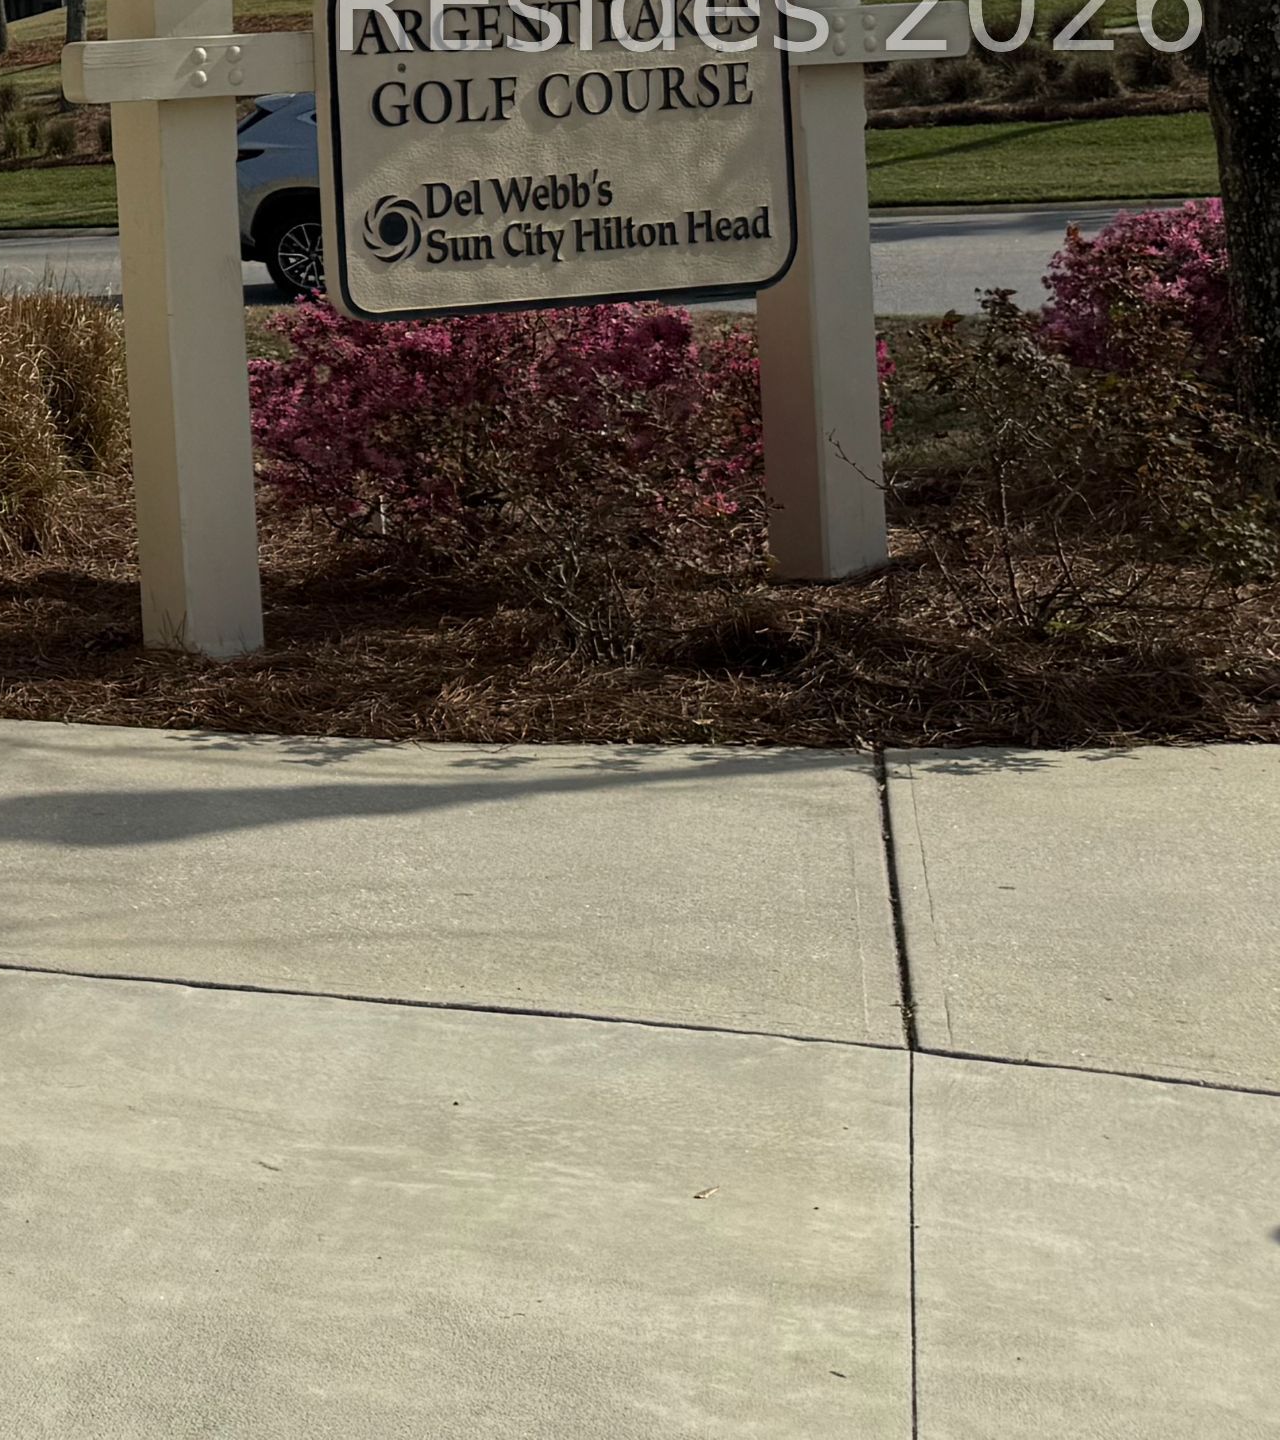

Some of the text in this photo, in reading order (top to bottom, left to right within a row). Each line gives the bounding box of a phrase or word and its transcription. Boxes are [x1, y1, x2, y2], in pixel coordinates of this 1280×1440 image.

[352, 0, 581, 57] ARGENT
[371, 61, 754, 128] GOLF COURSE
[422, 168, 615, 220] Del Webb's
[426, 205, 772, 264] Sun City Hilton Head
